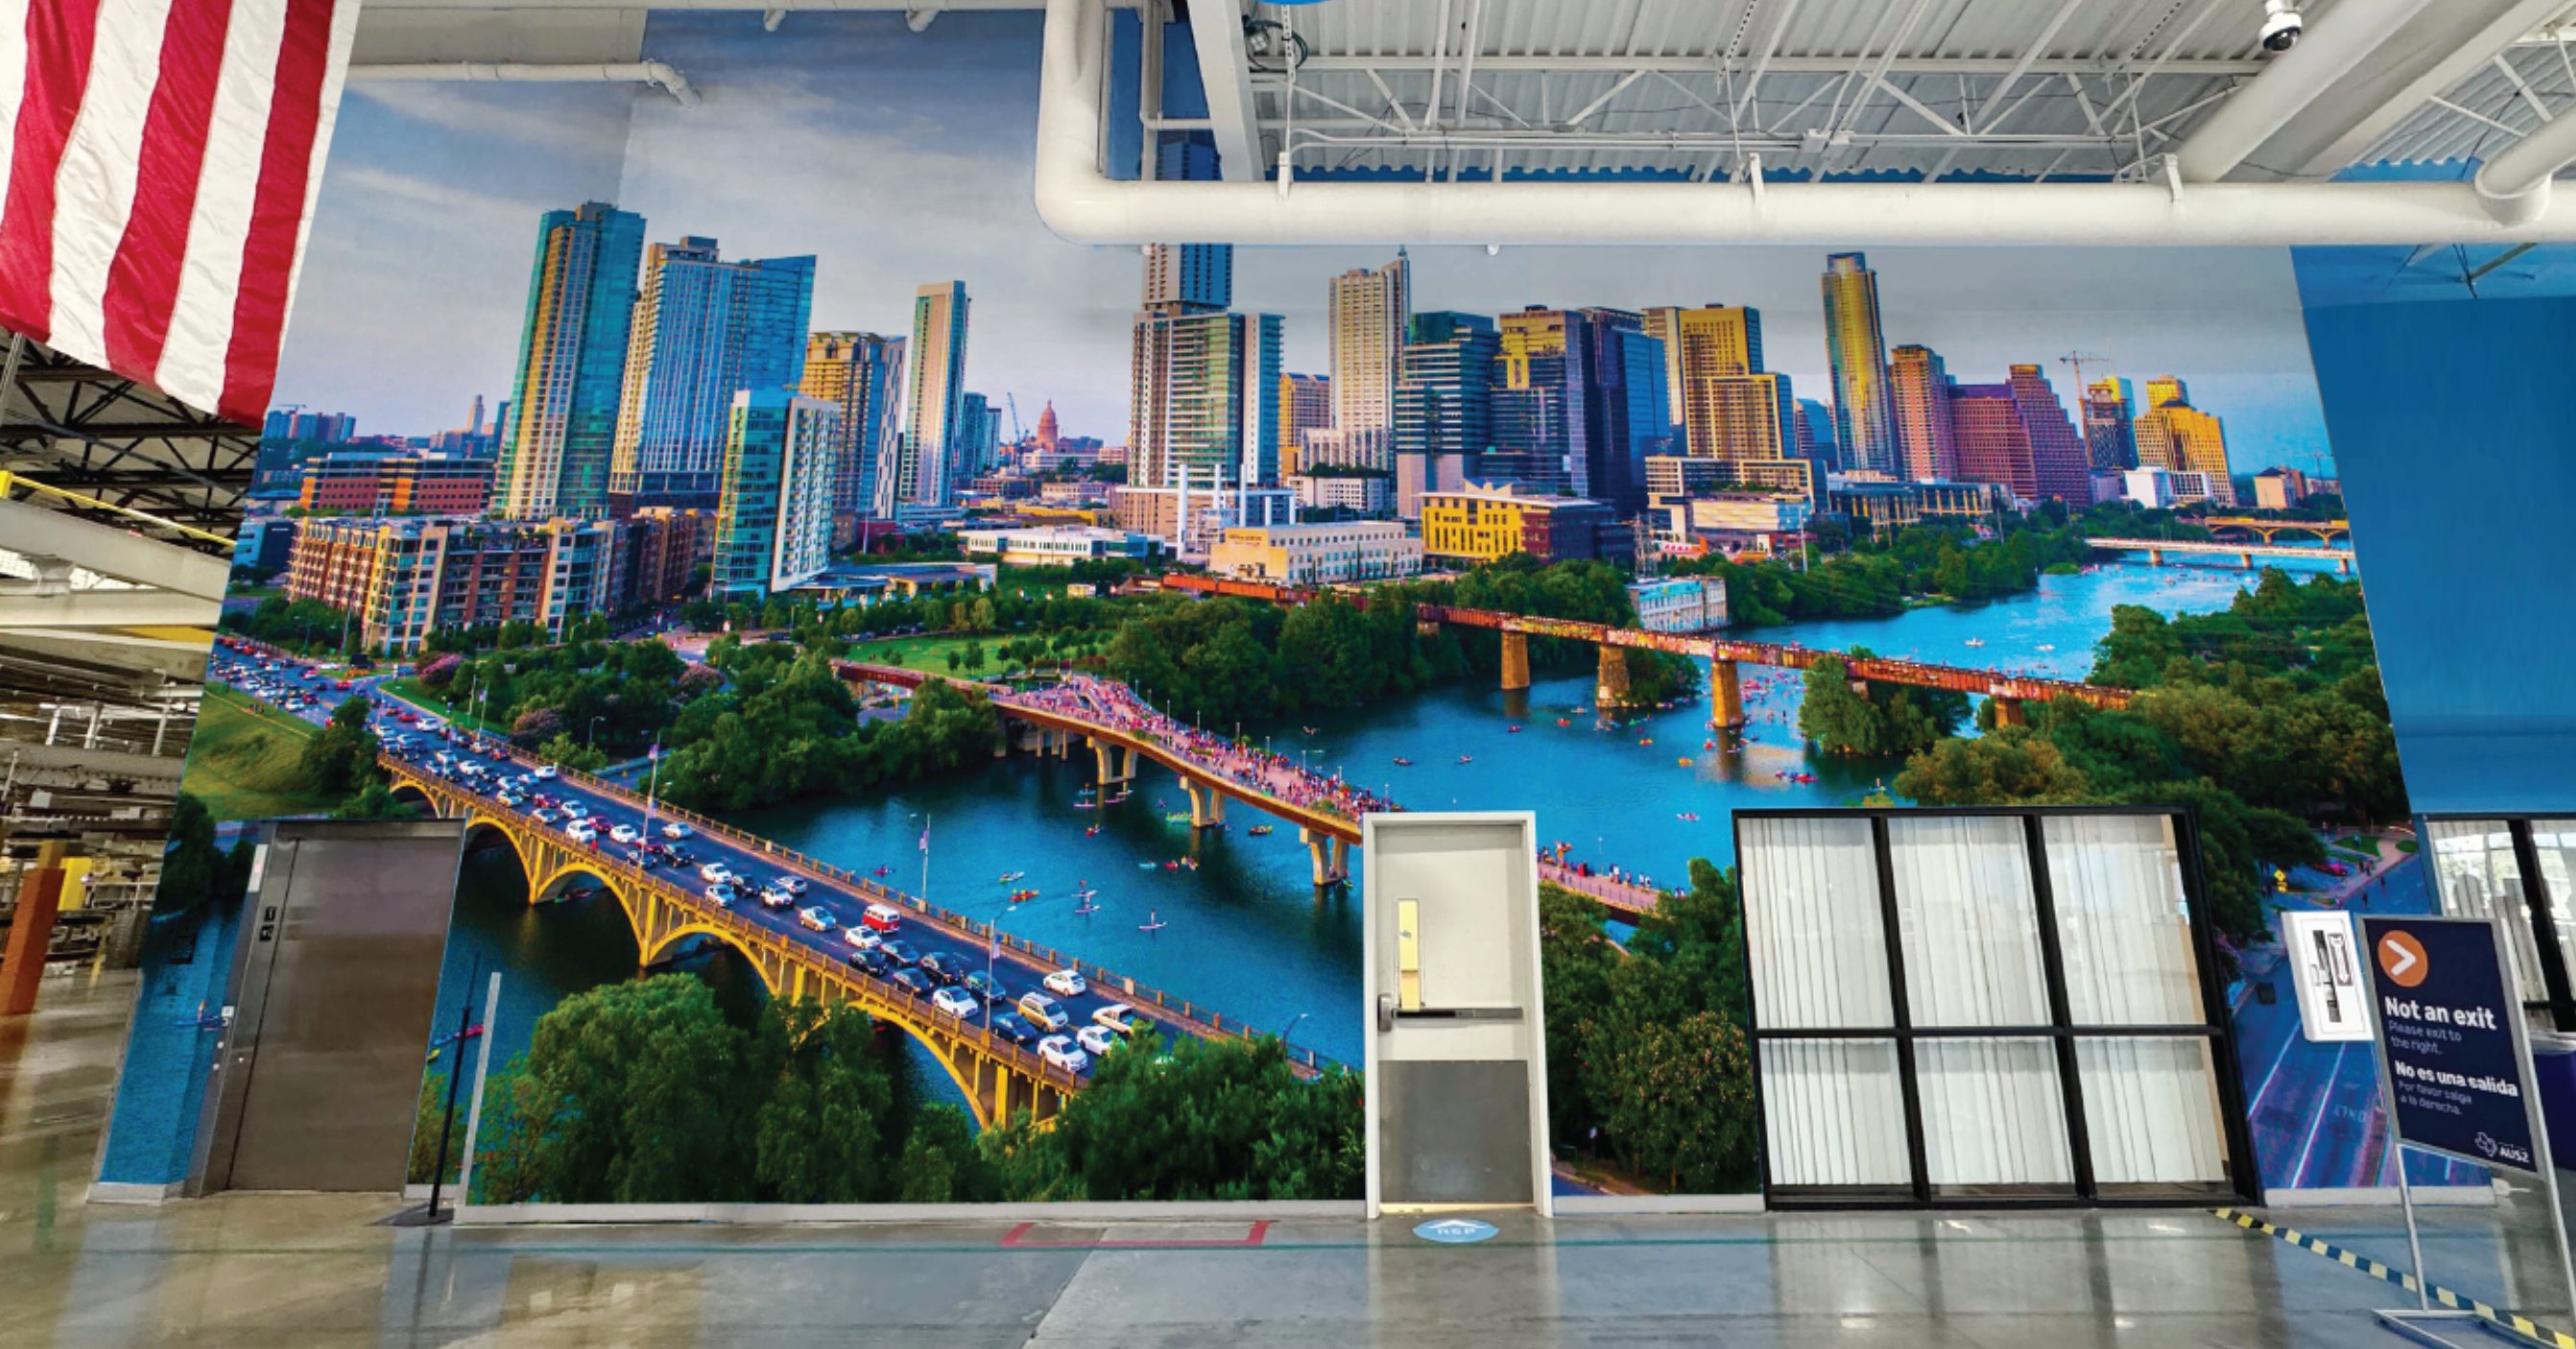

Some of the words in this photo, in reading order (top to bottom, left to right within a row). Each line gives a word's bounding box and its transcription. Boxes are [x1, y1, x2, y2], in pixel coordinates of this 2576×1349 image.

[2384, 996, 2421, 1020] Not
[2424, 1006, 2449, 1023] an
[2453, 1006, 2497, 1030] exit
[2389, 1020, 2423, 1036] Please
[2426, 1028, 2447, 1041] exit
[2448, 1030, 2462, 1042] to
[2391, 1035, 2409, 1049] the
[2395, 1060, 2416, 1077] No
[2417, 1068, 2435, 1082] es
[2436, 1072, 2468, 1087] una
[2468, 1076, 2518, 1097] salida
[2399, 1080, 2415, 1092] Por
[2417, 1083, 2443, 1098] favor
[2408, 1095, 2418, 1105] la
